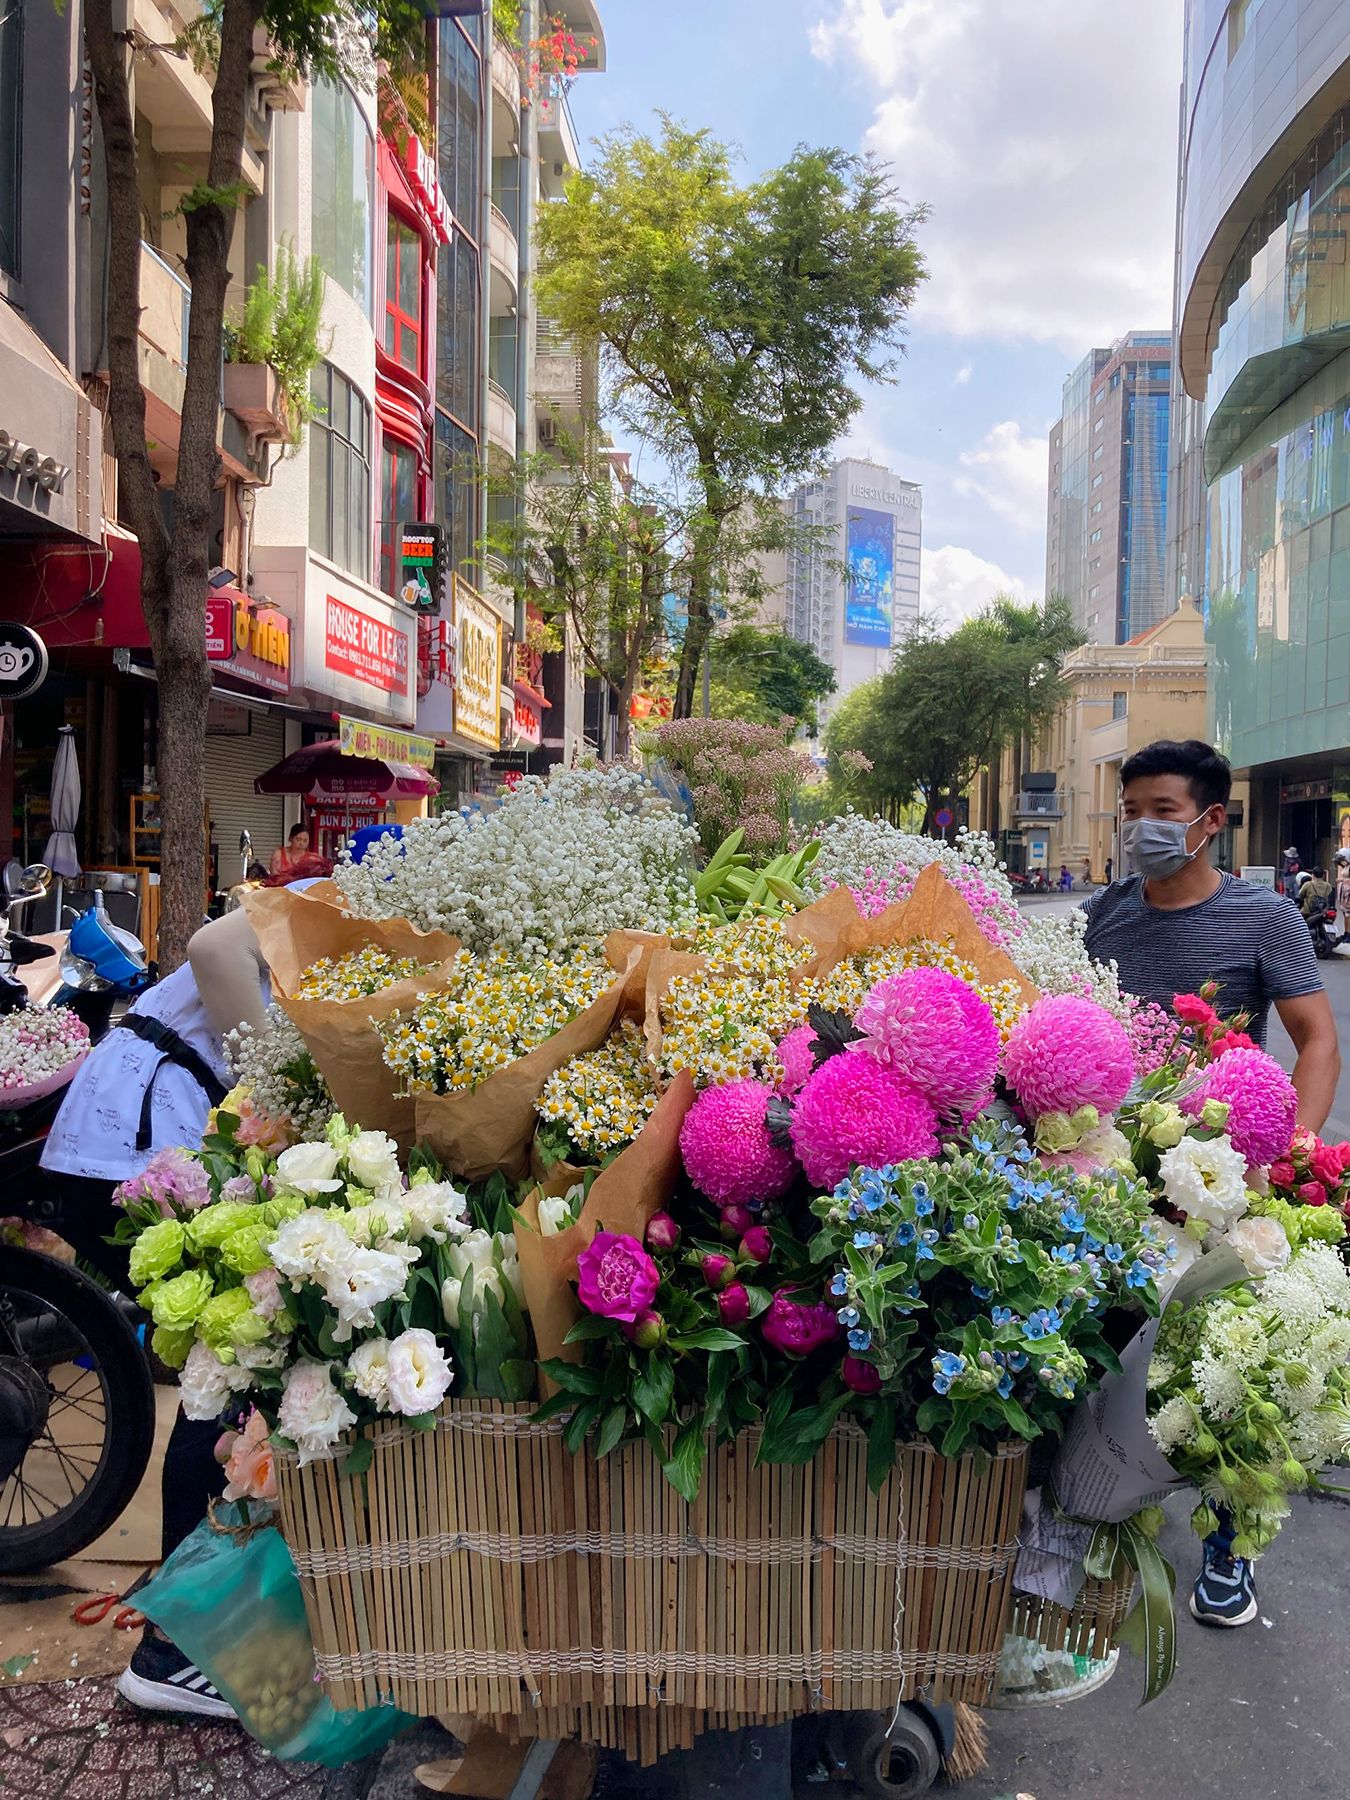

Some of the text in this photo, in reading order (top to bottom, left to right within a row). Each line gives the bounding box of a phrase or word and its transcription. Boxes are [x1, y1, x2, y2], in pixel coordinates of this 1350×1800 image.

[882, 490, 918, 509] CENTRAL
[402, 535, 435, 544] ROOFTOP
[402, 543, 433, 557] BEER
[327, 602, 359, 647] HOUSE
[361, 619, 379, 656] FOR
[381, 628, 407, 667] LEASE
[1156, 1625, 1166, 1653] Always
[1156, 1653, 1166, 1664] By
[1156, 1665, 1165, 1679] Your
